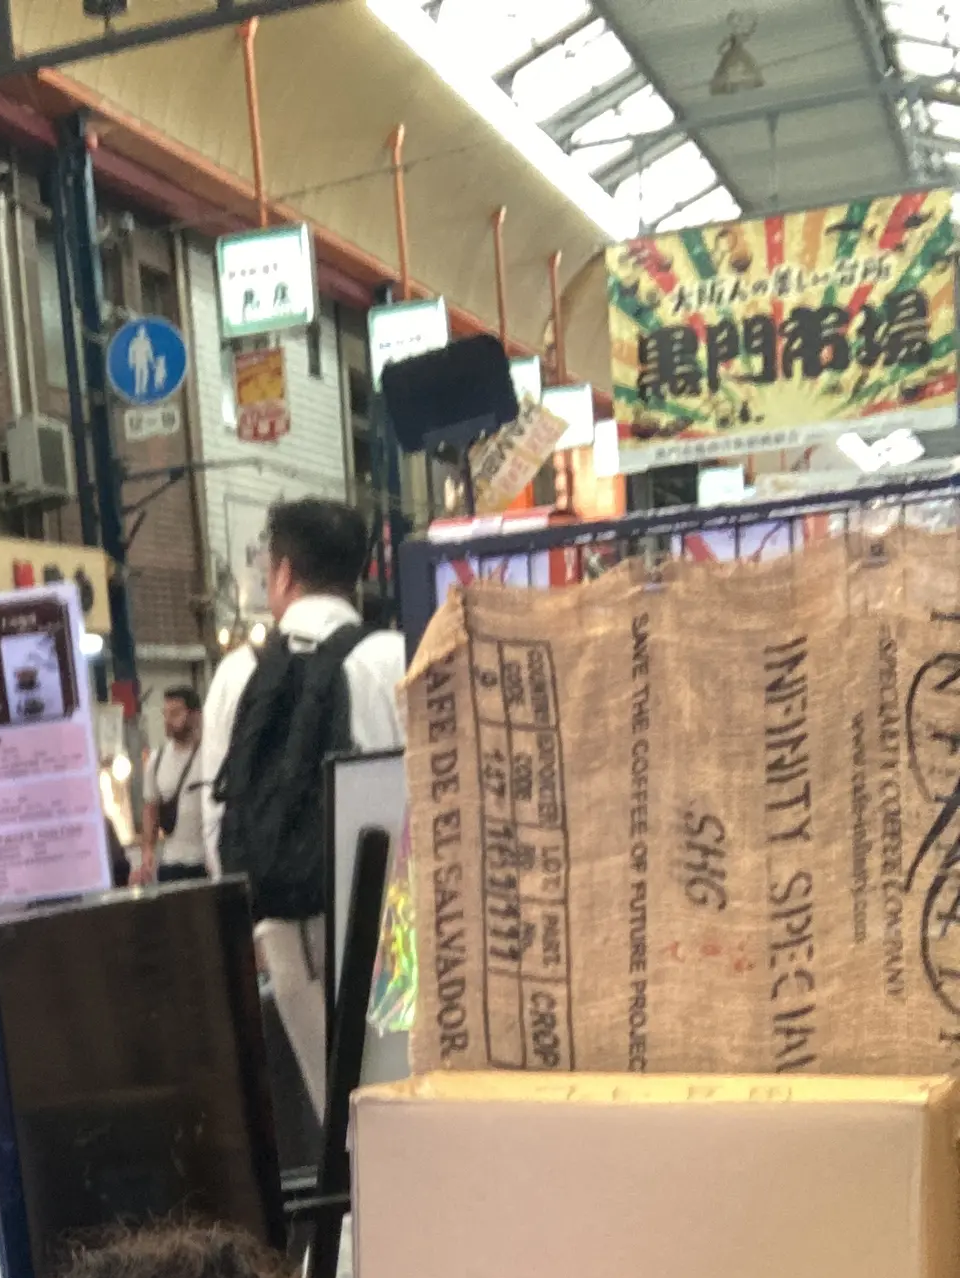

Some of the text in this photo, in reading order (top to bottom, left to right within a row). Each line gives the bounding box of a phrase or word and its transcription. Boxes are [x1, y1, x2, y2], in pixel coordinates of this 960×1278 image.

[637, 289, 933, 404] 黒門市場
[631, 612, 650, 680] SAVE
[631, 684, 650, 735] THE
[765, 636, 810, 843] INFINITY
[631, 739, 649, 837] COFFEE
[426, 656, 469, 1060] AFE DE EL SALVADOR
[630, 840, 648, 874] OF
[682, 811, 727, 912] SHG
[629, 880, 647, 973] FUTURE
[531, 990, 561, 1069] CROP
